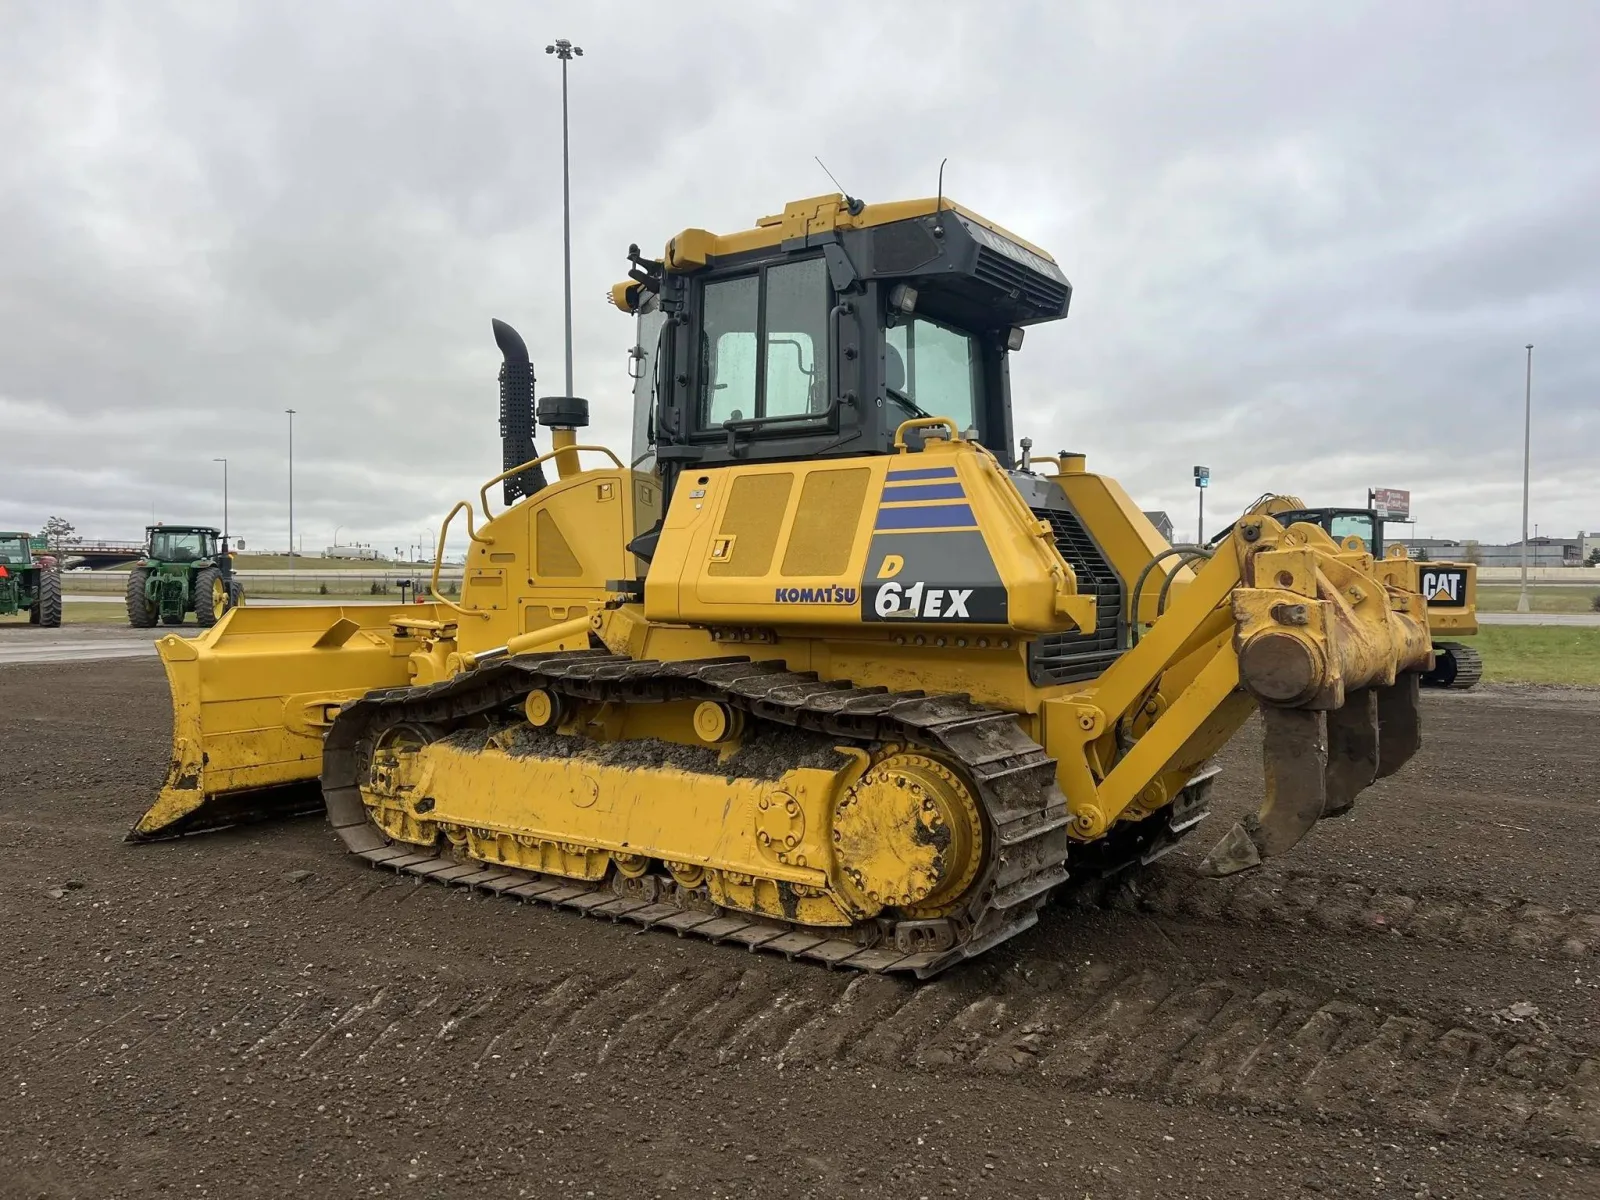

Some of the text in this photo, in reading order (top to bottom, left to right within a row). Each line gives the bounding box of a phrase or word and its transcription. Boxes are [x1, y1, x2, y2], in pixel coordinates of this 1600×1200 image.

[877, 555, 904, 578] D
[775, 584, 855, 602] KOMATSU
[1423, 573, 1460, 600] CAT
[875, 582, 973, 617] 61EX
